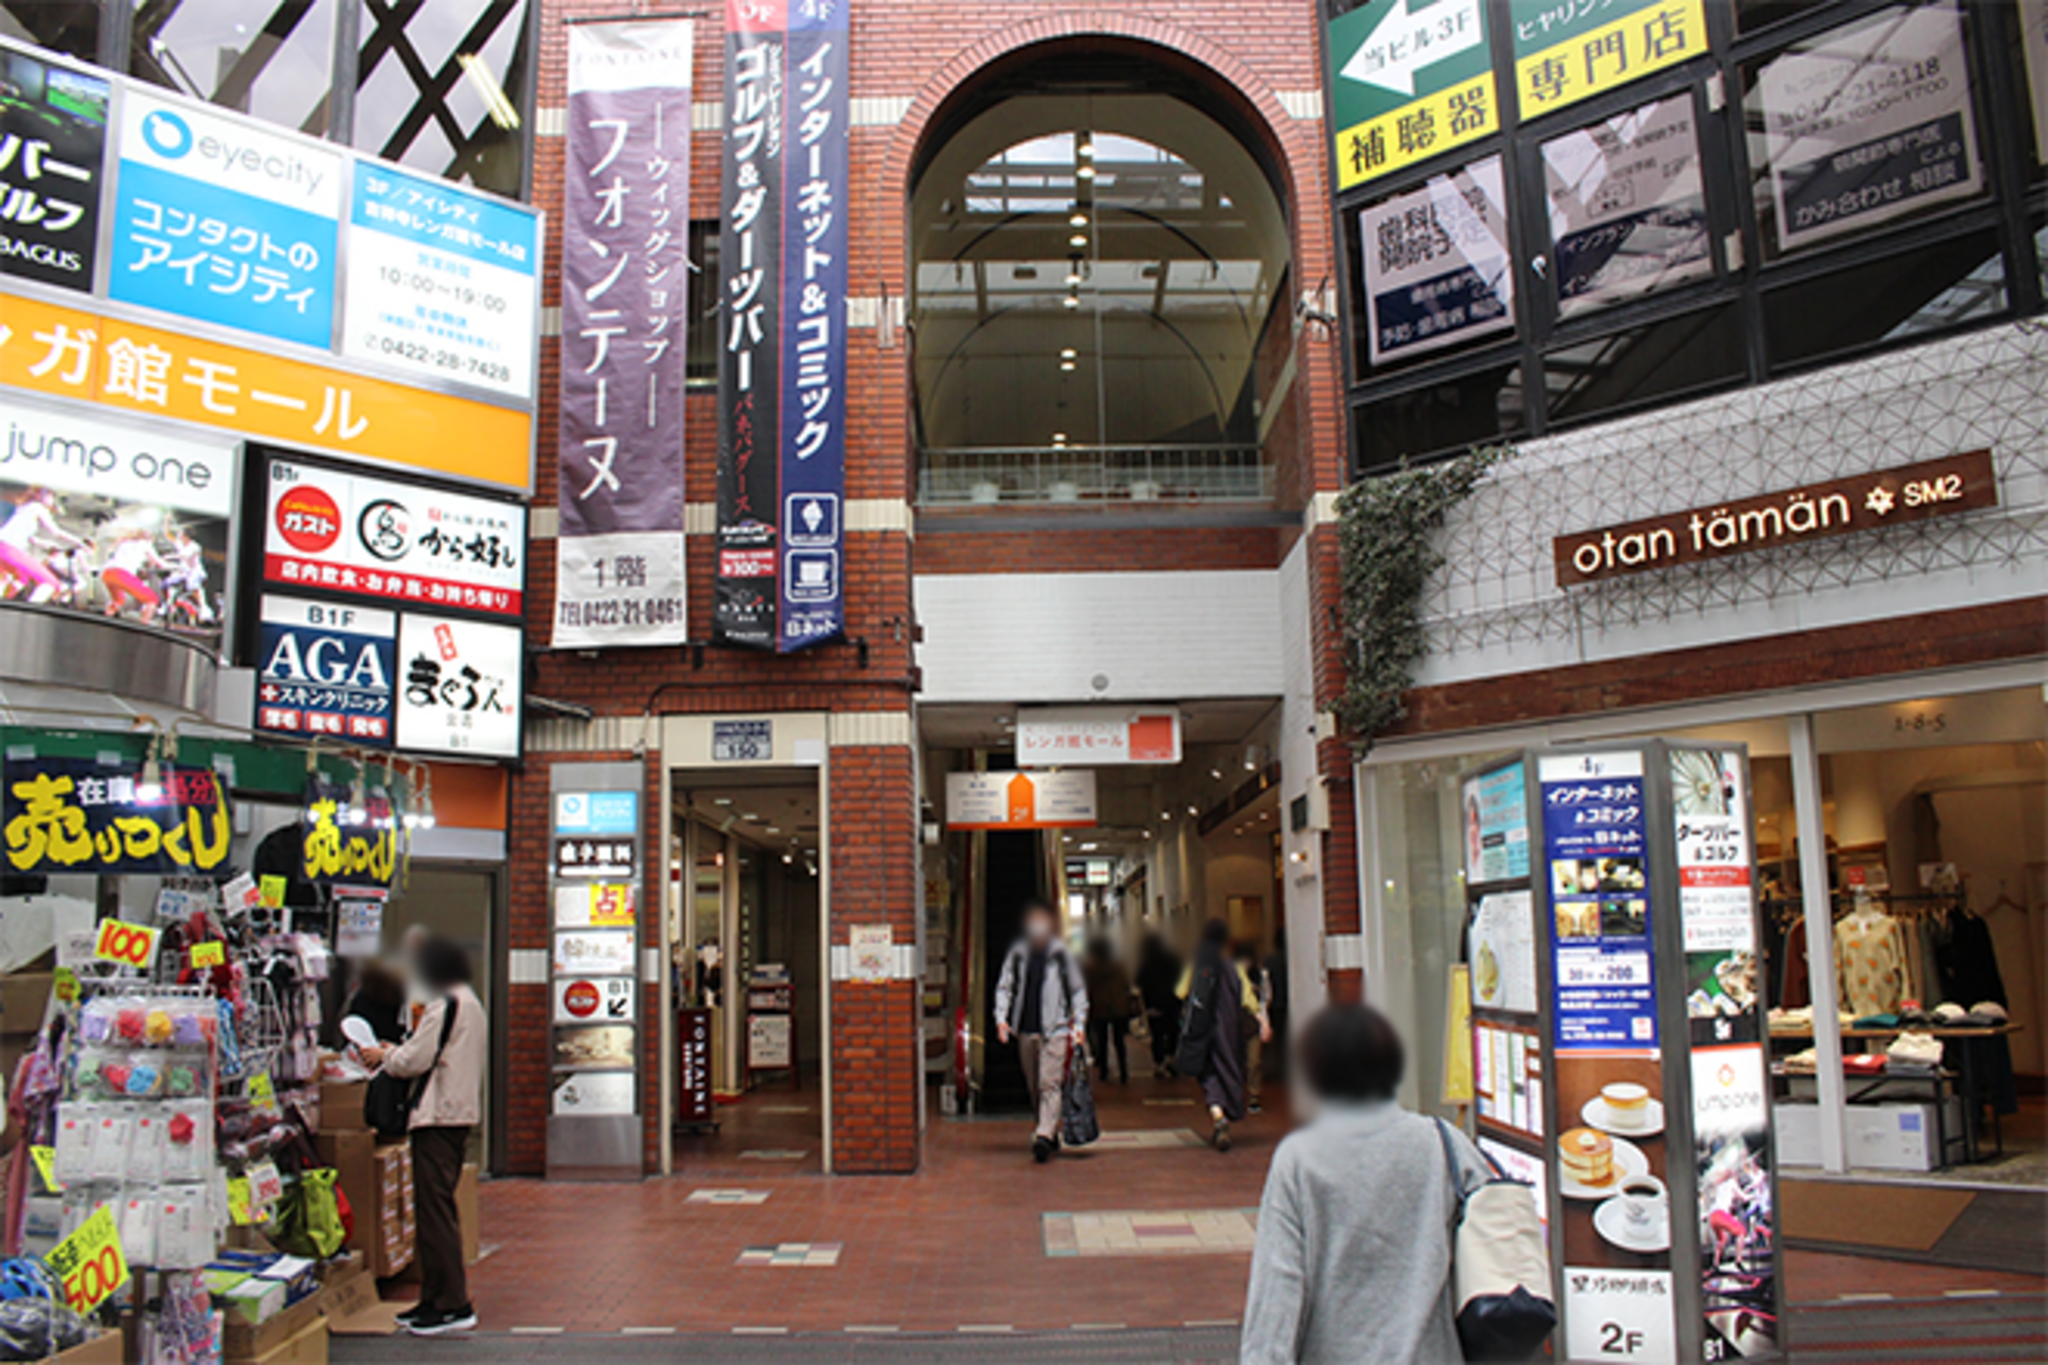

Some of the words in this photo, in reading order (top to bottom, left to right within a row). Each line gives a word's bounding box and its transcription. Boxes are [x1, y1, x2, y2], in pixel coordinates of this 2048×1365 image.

[1364, 9, 1472, 72] 当ビル3F
[1527, 7, 1687, 101] 専門店
[1350, 86, 1487, 174] 補聴器
[199, 132, 324, 196] eyecity
[1796, 178, 1903, 227] かみ合わせ
[131, 197, 319, 272] コンタクトの
[128, 232, 315, 314] アイシティ
[579, 120, 631, 500] フォンテーヌ
[1, 422, 117, 476] jump
[131, 450, 212, 490] one
[283, 511, 337, 539] ガスト
[418, 527, 517, 570] から好し
[1572, 526, 1676, 574] otan
[1688, 492, 1852, 552] tämän
[1903, 473, 1963, 508] SM2
[281, 560, 511, 610] 店内飲食・お弁当・お持ち帰り
[307, 604, 356, 627] B1F
[262, 631, 391, 690] AGA
[279, 686, 389, 713] スキンクリニック
[5, 770, 230, 870] 売りつくし
[1548, 784, 1640, 804] インターネット
[595, 886, 619, 915] 占
[98, 923, 152, 964] 100
[63, 1245, 121, 1314] 500
[1599, 1321, 1644, 1355] 2F
